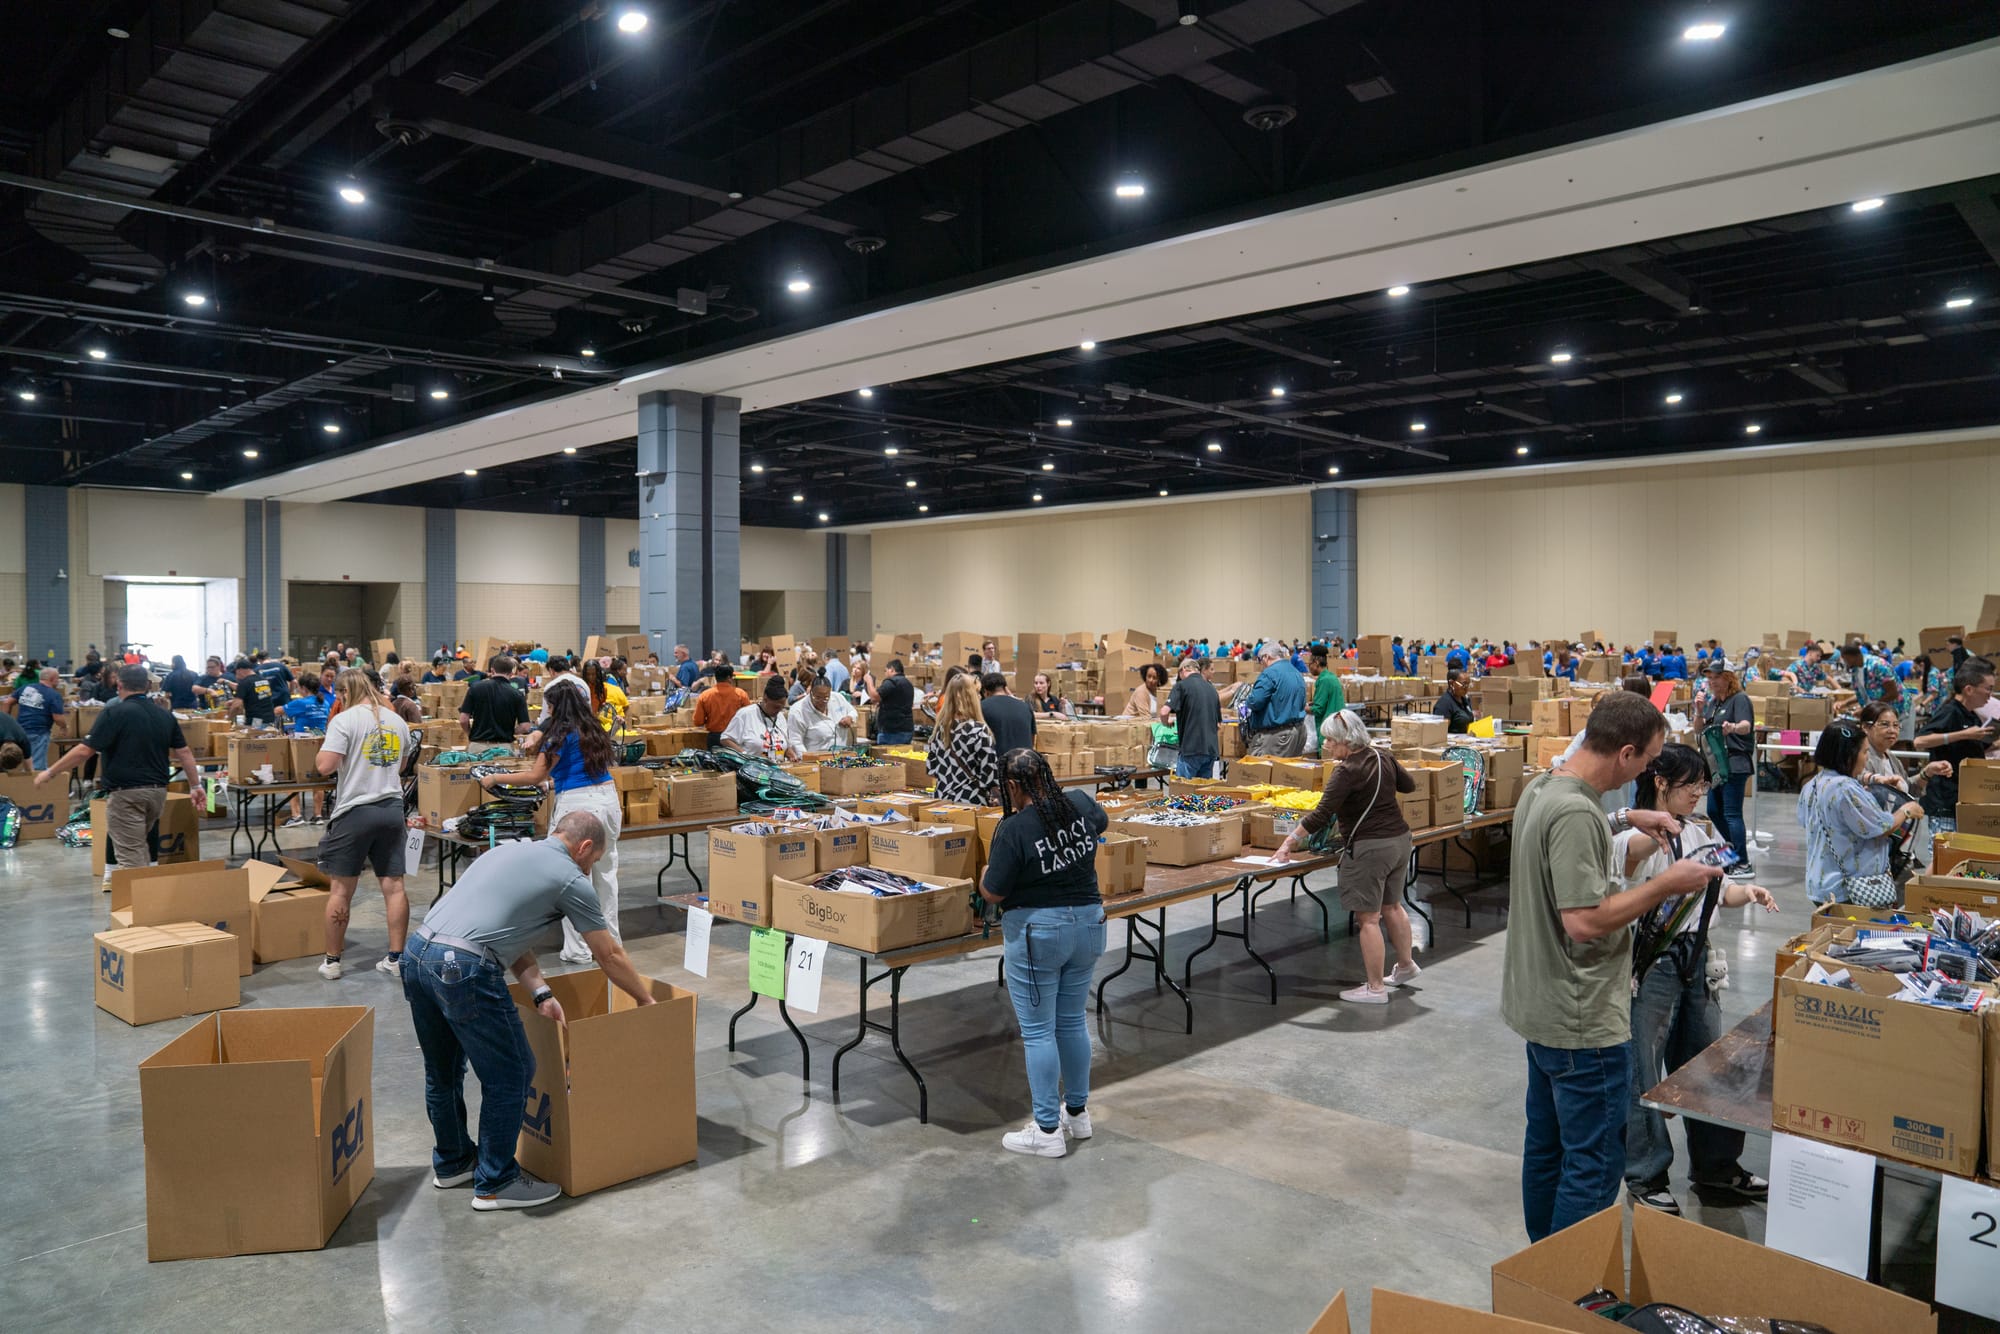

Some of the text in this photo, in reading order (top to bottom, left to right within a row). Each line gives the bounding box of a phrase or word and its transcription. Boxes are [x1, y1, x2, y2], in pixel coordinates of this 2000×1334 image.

[159, 833, 184, 853] CA
[409, 837, 420, 850] 20
[1035, 816, 1087, 858] FUNKY
[1041, 835, 1094, 874] LANDS
[809, 902, 846, 923] BigBox
[100, 947, 125, 986] PCA
[798, 951, 813, 970] 21
[1826, 1000, 1882, 1021] BAZIC
[521, 1086, 552, 1138] CA
[1906, 1120, 1932, 1134] 3004
[331, 1097, 364, 1179] PCA
